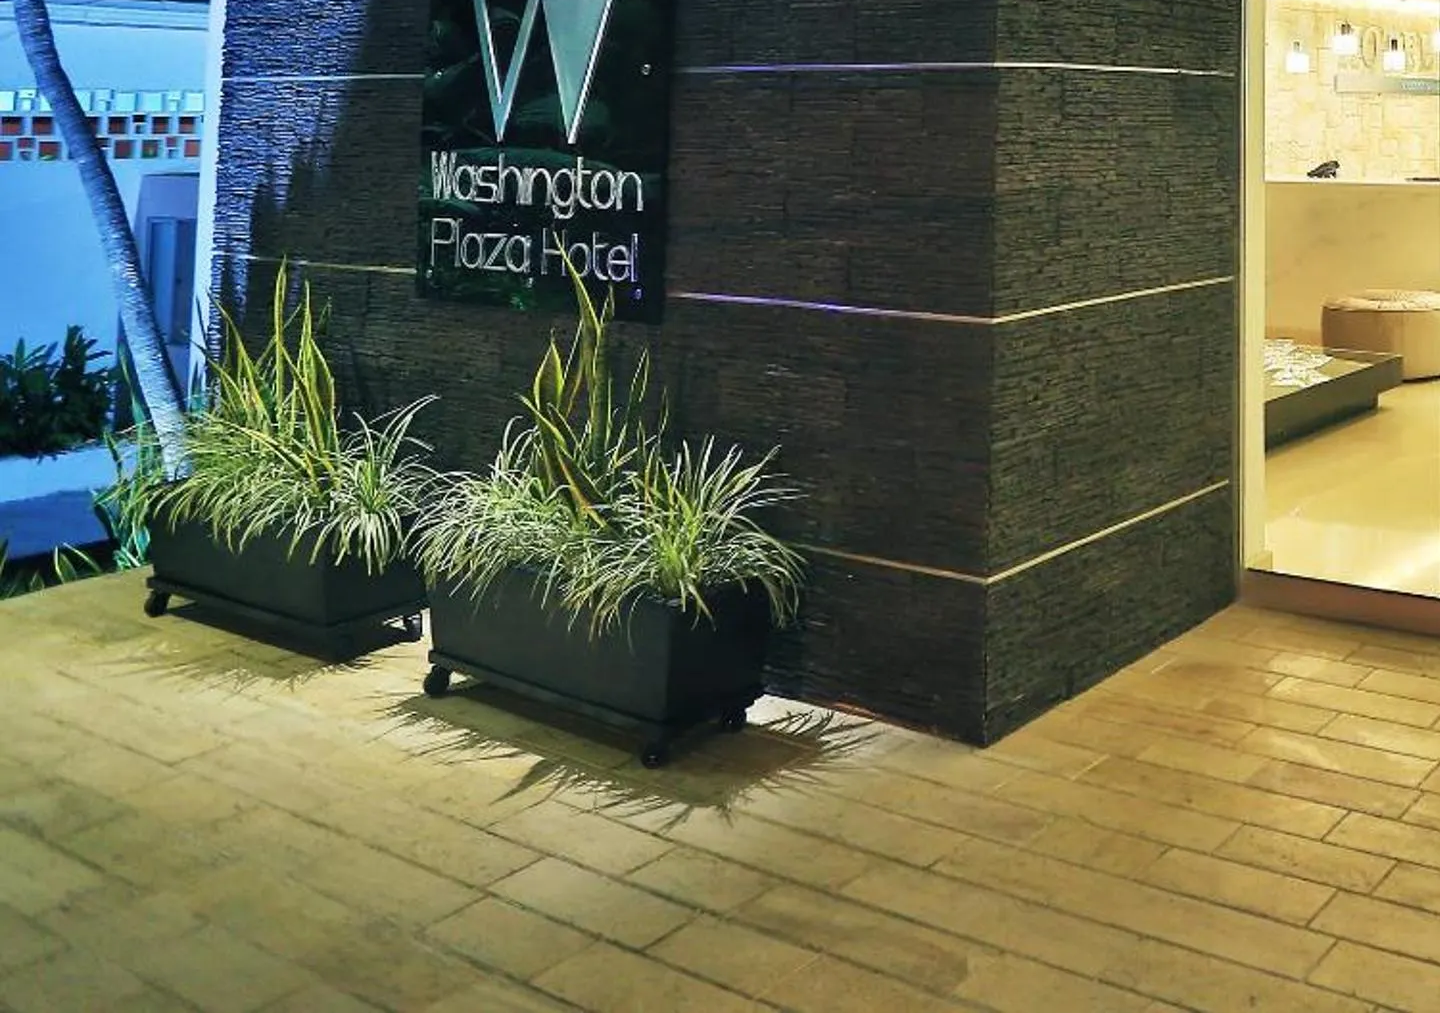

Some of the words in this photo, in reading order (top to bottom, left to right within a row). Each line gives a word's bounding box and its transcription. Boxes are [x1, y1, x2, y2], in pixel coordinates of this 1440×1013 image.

[430, 150, 644, 220] Washington
[430, 217, 533, 274] Plaza
[540, 227, 639, 283] Hotel
